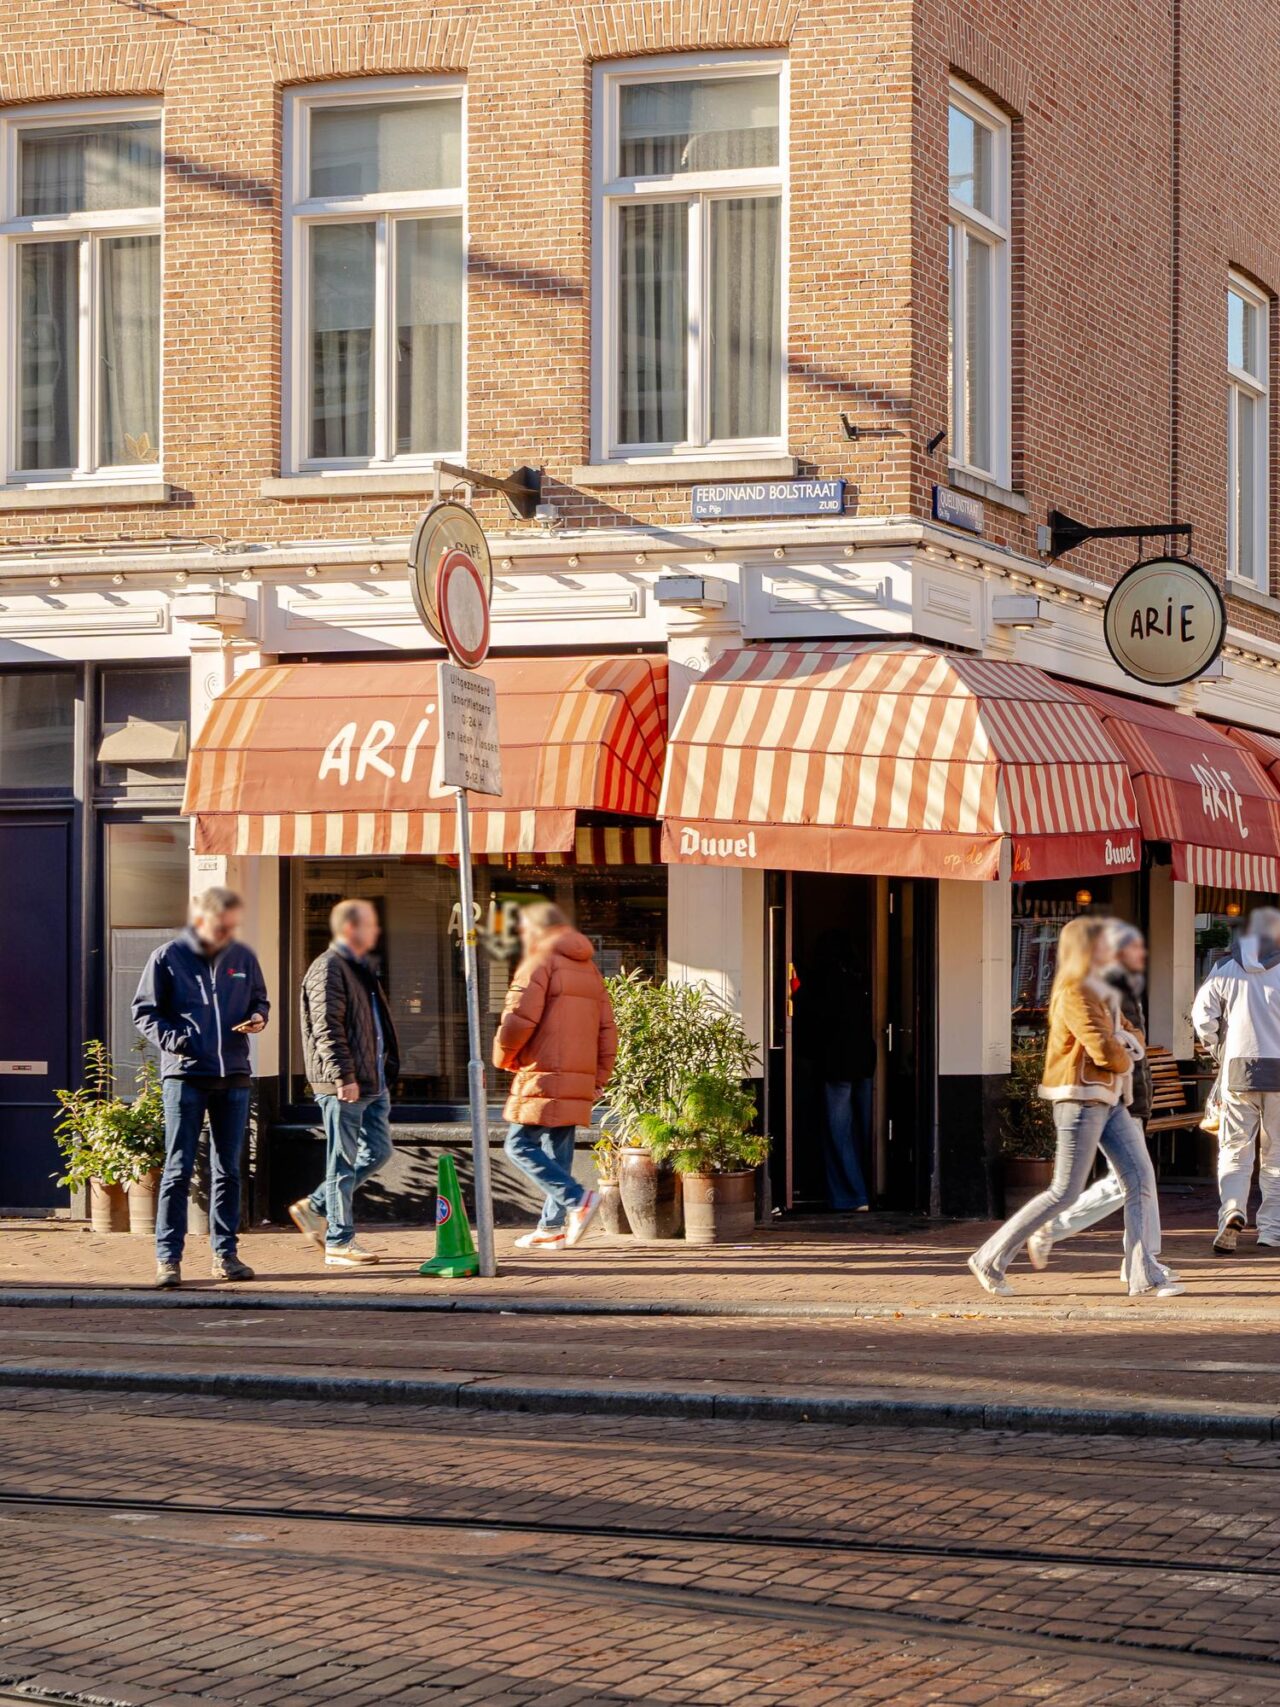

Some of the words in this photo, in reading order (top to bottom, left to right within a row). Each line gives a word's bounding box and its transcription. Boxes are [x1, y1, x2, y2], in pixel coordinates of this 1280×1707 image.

[697, 486, 765, 502] FERDINAND
[769, 483, 837, 499] BOLSTRAAT
[697, 506, 706, 514] De
[709, 505, 721, 515] Pijp
[819, 501, 838, 510] ZUID
[447, 730, 455, 740] en
[680, 826, 757, 858] Duvel
[1105, 837, 1136, 865] Duvel
[943, 854, 961, 872] op
[966, 844, 983, 864] de
